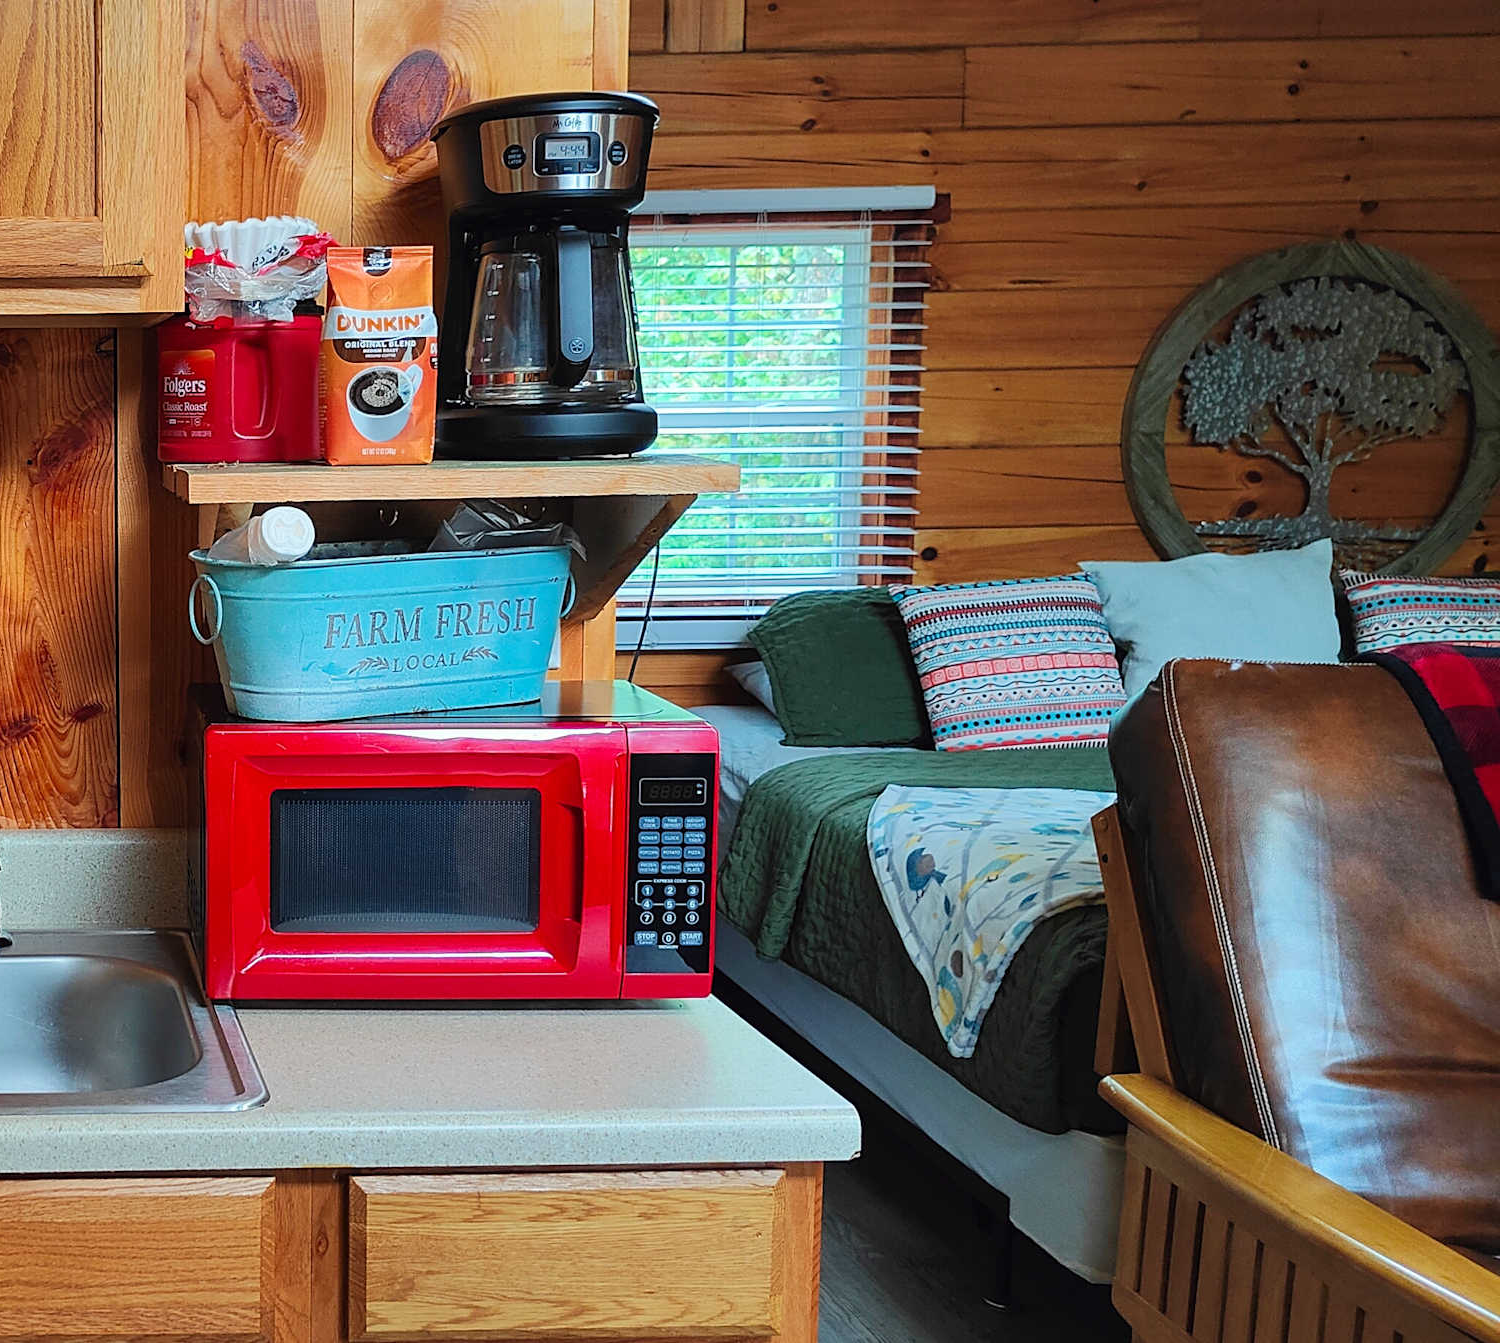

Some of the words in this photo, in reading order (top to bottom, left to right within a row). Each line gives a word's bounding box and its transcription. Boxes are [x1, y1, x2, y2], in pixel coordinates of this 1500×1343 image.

[344, 340, 387, 349] ORIGINAL
[388, 339, 417, 348] BLEND
[163, 376, 206, 397] Folgers
[162, 401, 183, 412] Classic
[184, 401, 207, 412] Roast
[324, 606, 424, 649] FARM
[434, 597, 537, 639] FRESH
[392, 652, 461, 673] LOCAL
[644, 887, 650, 895] 1
[667, 887, 673, 895] 2
[690, 887, 696, 895] 3
[644, 900, 649, 908] 4
[667, 900, 672, 909] 5
[690, 900, 695, 908] 6
[644, 914, 650, 922] 7
[666, 914, 672, 922] 8
[689, 914, 695, 922] 9
[665, 934, 672, 942] 0
